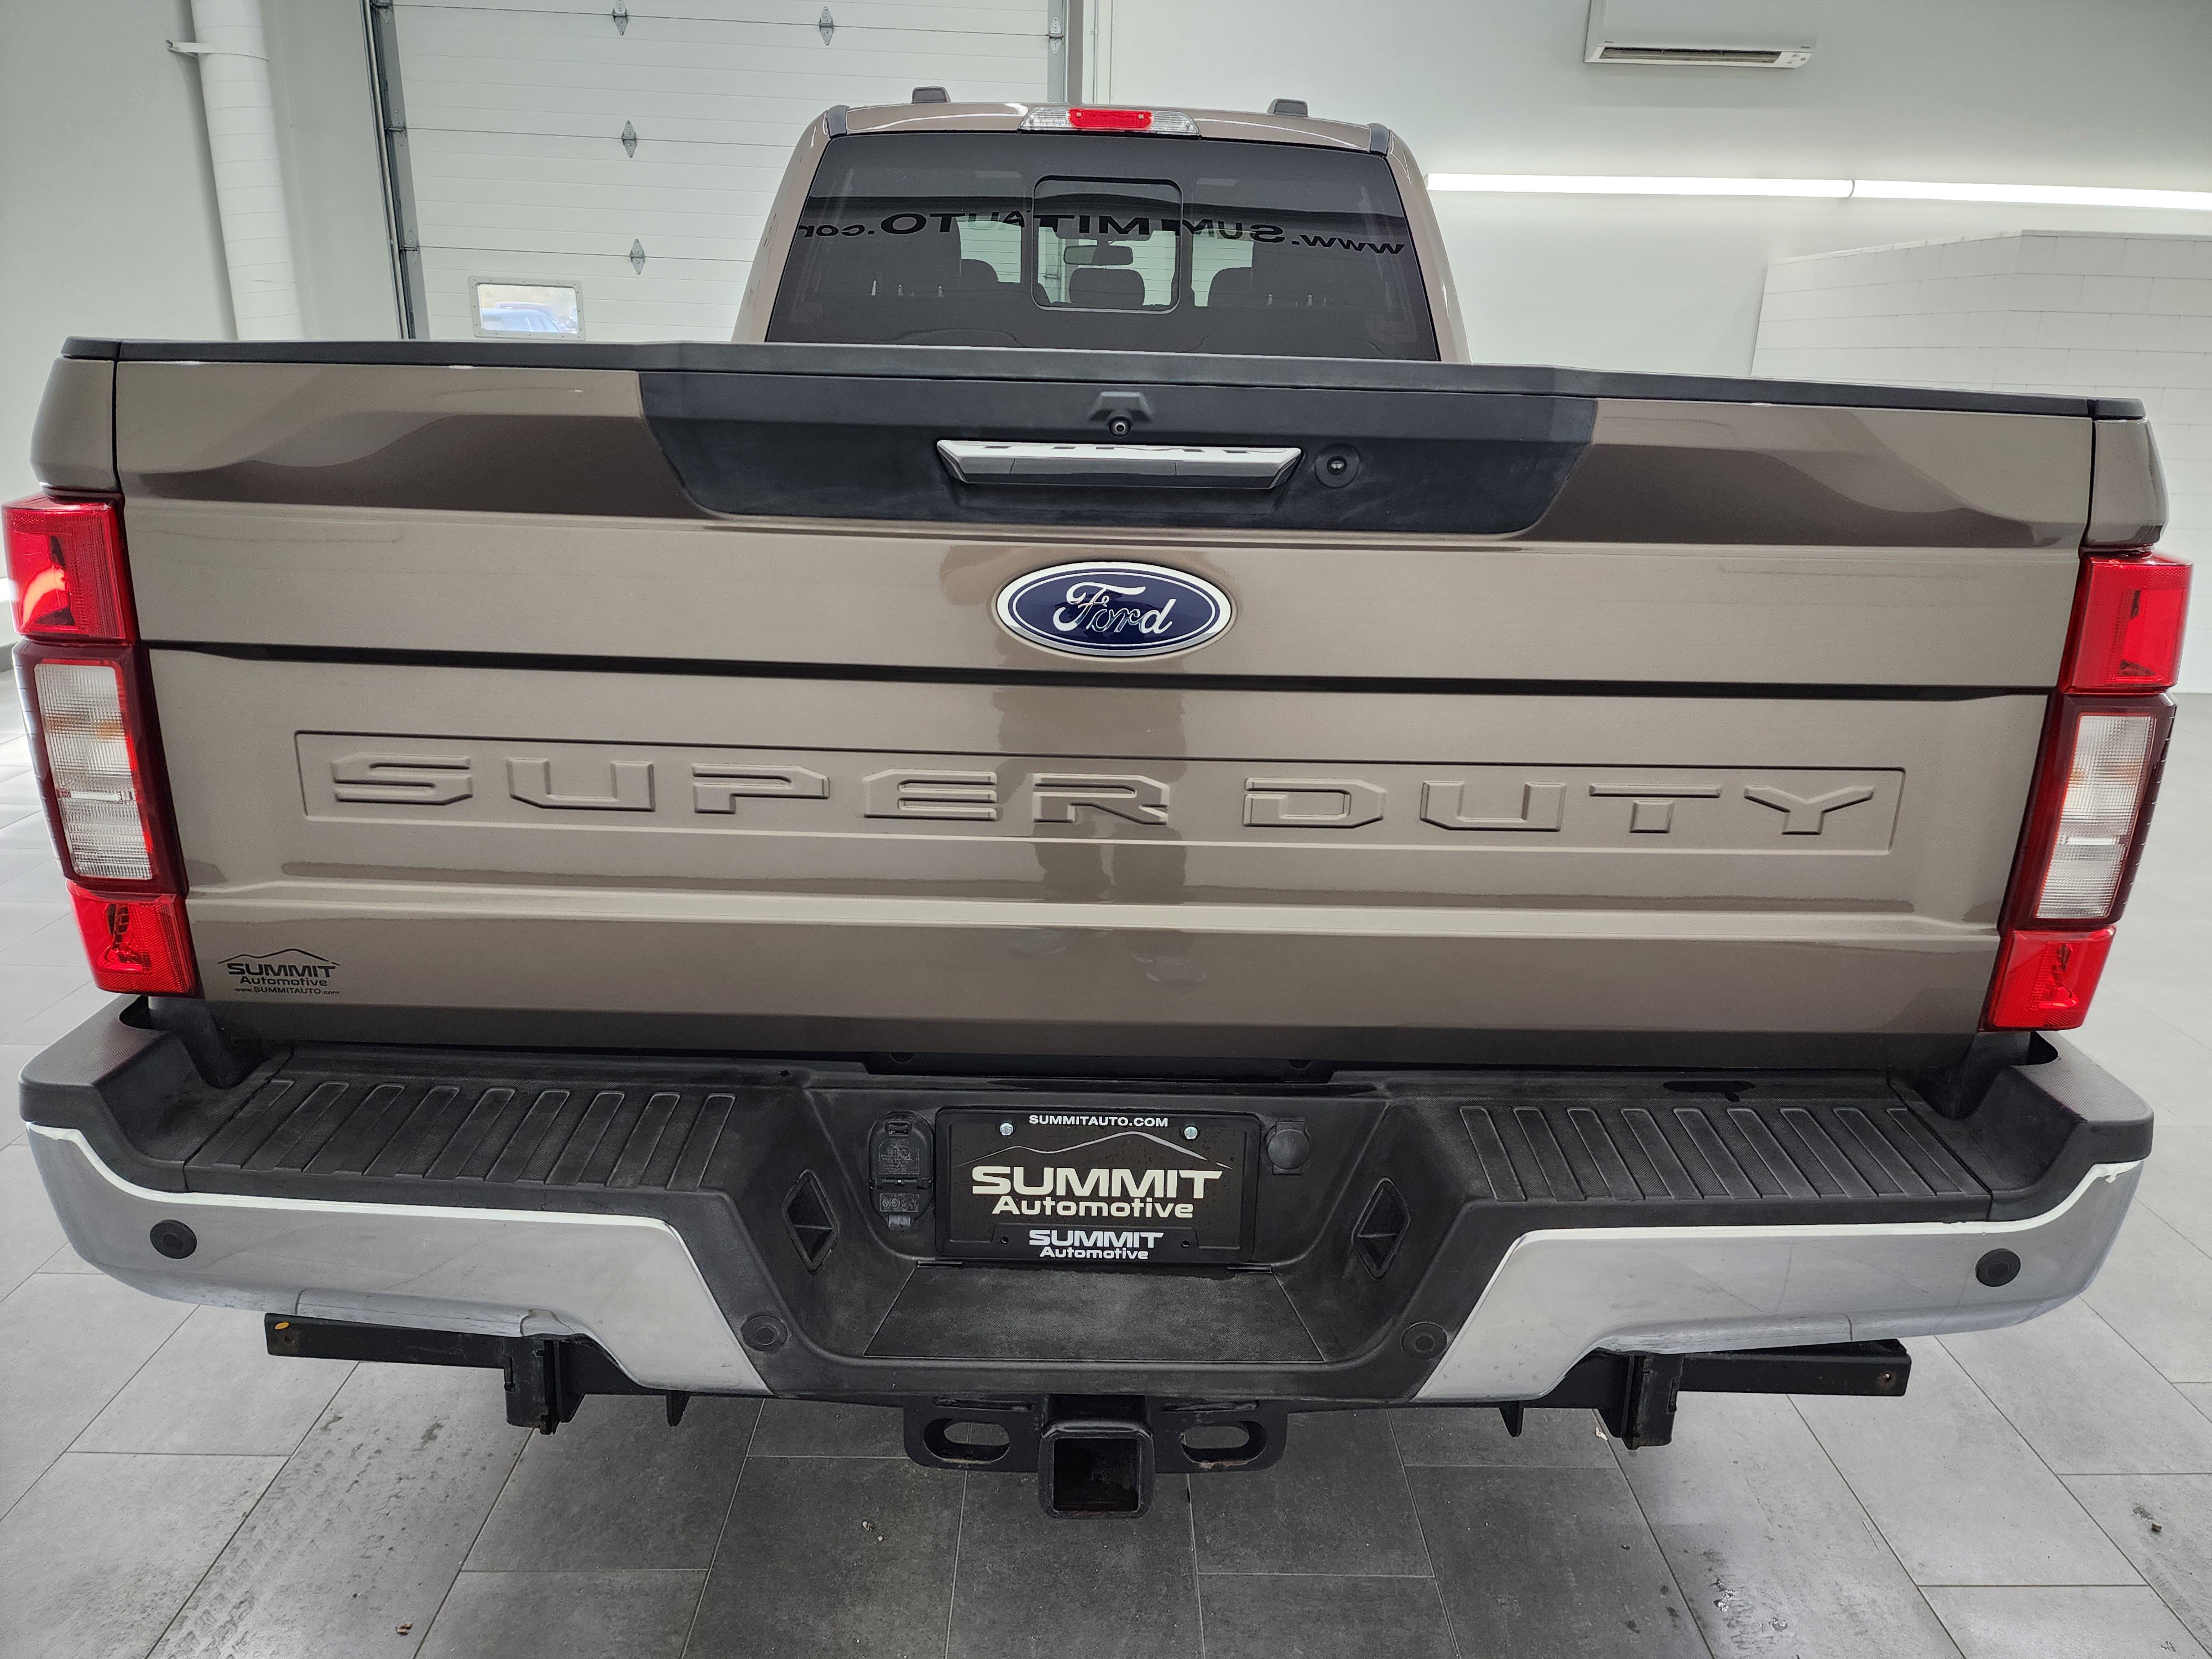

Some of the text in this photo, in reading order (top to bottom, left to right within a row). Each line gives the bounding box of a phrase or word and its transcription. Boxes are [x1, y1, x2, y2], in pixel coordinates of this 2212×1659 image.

[1053, 581, 1176, 634] Ford
[331, 753, 1875, 836] SUPER DUTY
[227, 963, 336, 978] SUMMIT
[240, 975, 327, 986] Automotive
[234, 987, 340, 995] www.SUMMITAUTO.com
[1028, 1114, 1168, 1127] SUMMITAUTO.COM
[971, 1166, 1223, 1199] SUMMIT
[992, 1195, 1194, 1218] Automotive
[1029, 1229, 1164, 1249] SUMMIT
[1039, 1246, 1149, 1260] Automotive
